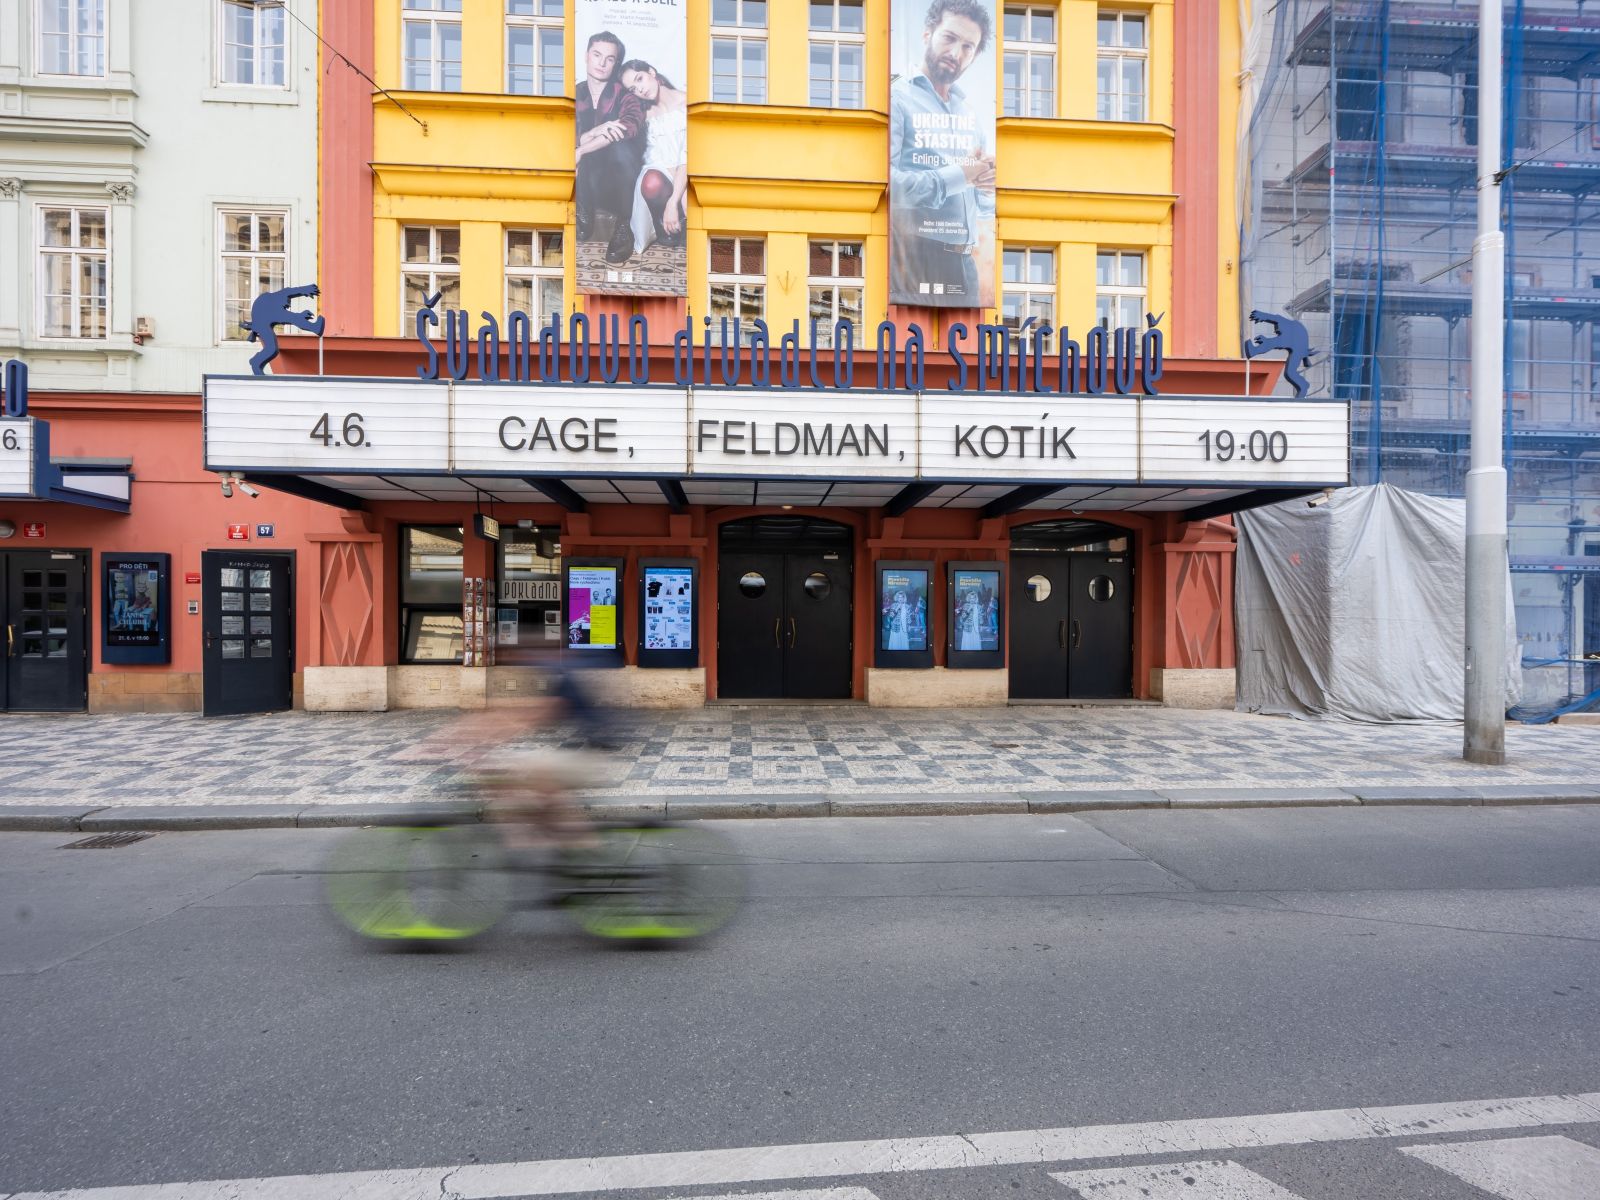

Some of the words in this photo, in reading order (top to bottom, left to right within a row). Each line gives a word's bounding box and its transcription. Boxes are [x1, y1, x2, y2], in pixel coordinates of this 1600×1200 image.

[912, 153, 940, 167] Erling
[674, 315, 853, 389] divadlo
[876, 320, 925, 391] na
[309, 412, 371, 448] 4.6.
[499, 415, 635, 459] CAGE,
[697, 418, 906, 462] FELDMAN,
[954, 412, 1077, 460] KOTÍK
[1198, 428, 1289, 463] 19:00
[260, 526, 270, 535] 57
